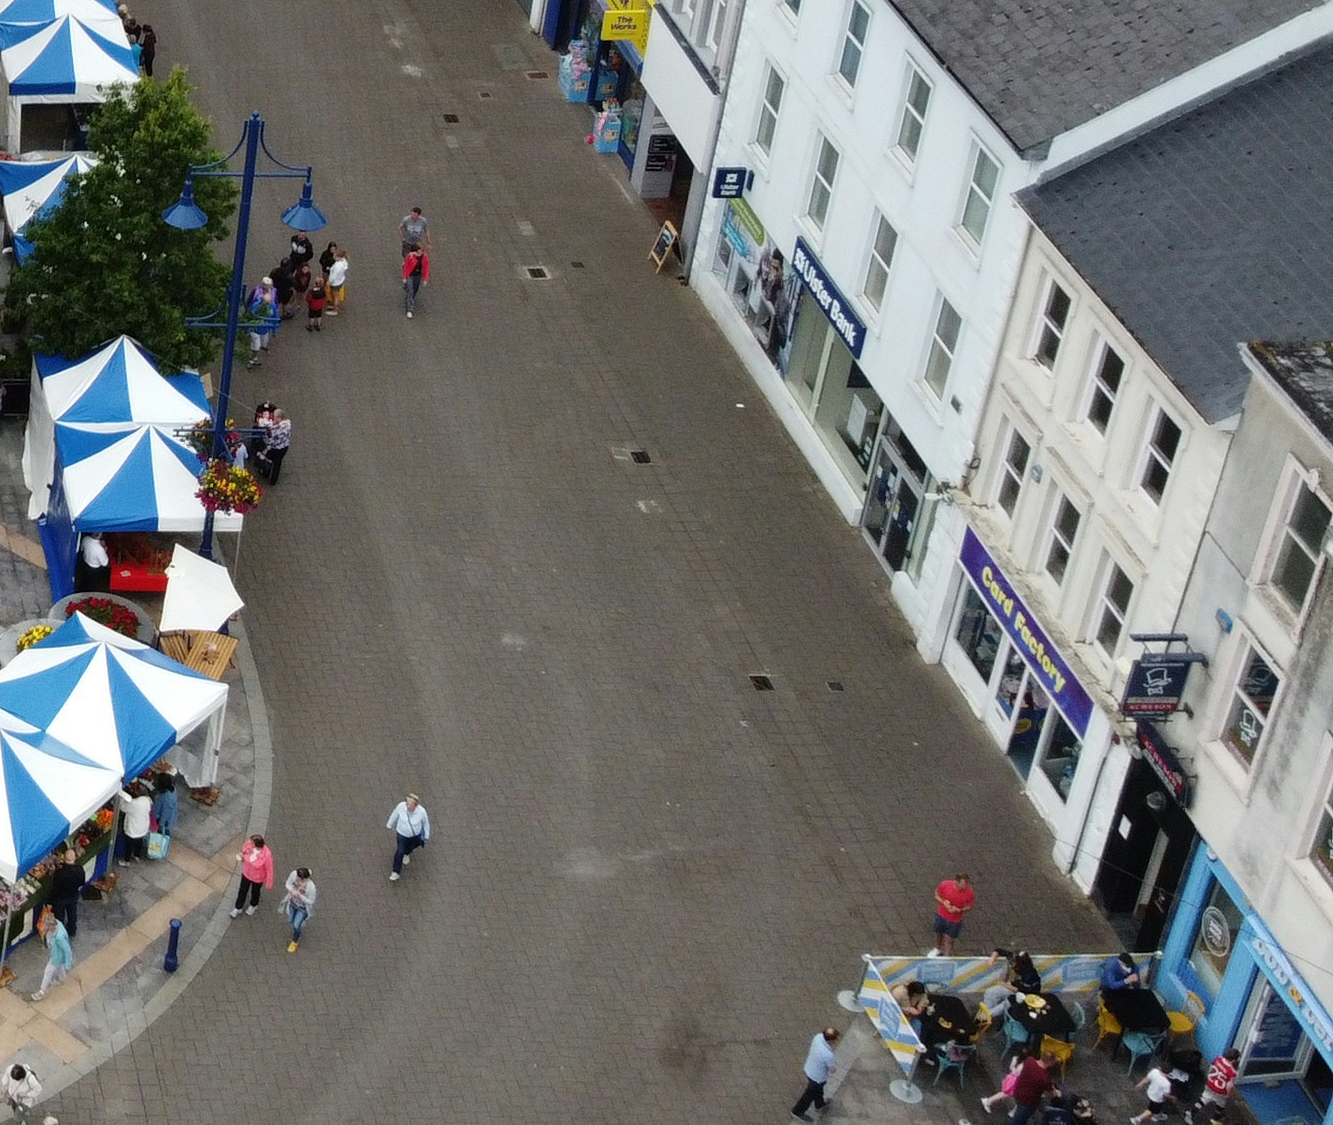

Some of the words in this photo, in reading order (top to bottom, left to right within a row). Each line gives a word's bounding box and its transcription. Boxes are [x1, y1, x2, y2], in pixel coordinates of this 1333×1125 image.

[610, 23, 637, 31] Works
[617, 16, 633, 24] The
[803, 259, 832, 310] Ulster
[830, 299, 857, 347] Bank
[982, 565, 1014, 617] Card
[1014, 610, 1066, 693] Factory
[1208, 1064, 1227, 1090] 25
